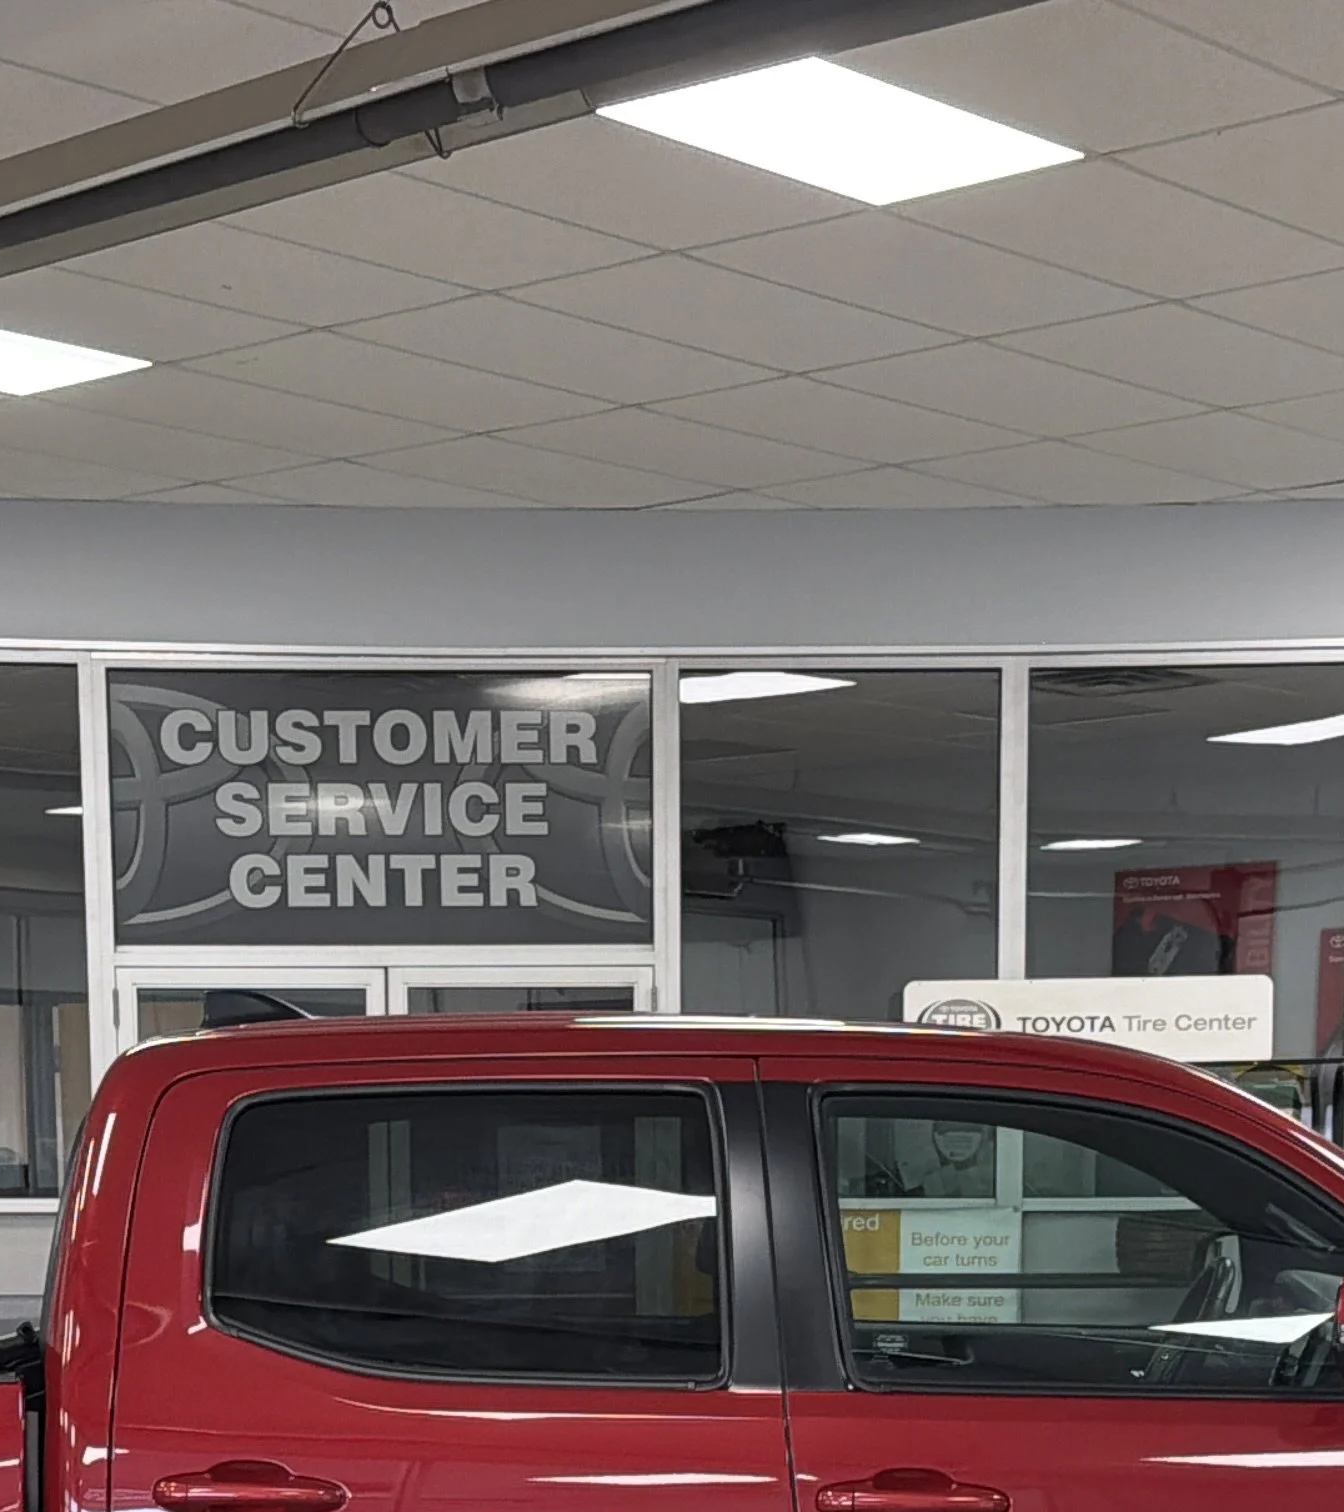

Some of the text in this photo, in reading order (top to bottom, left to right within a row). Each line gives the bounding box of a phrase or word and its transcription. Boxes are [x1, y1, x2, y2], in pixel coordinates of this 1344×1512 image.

[160, 709, 600, 767] CUSTOMER
[214, 781, 551, 838] SERVICE
[228, 853, 539, 910] CENTER
[1140, 875, 1180, 886] TOYOTA
[931, 1013, 987, 1029] TIRE
[1017, 1013, 1258, 1033] TOYOTA Tire Center
[911, 1231, 1011, 1250] Before your
[922, 1254, 998, 1268] car turns
[914, 1293, 1005, 1308] Make sure
